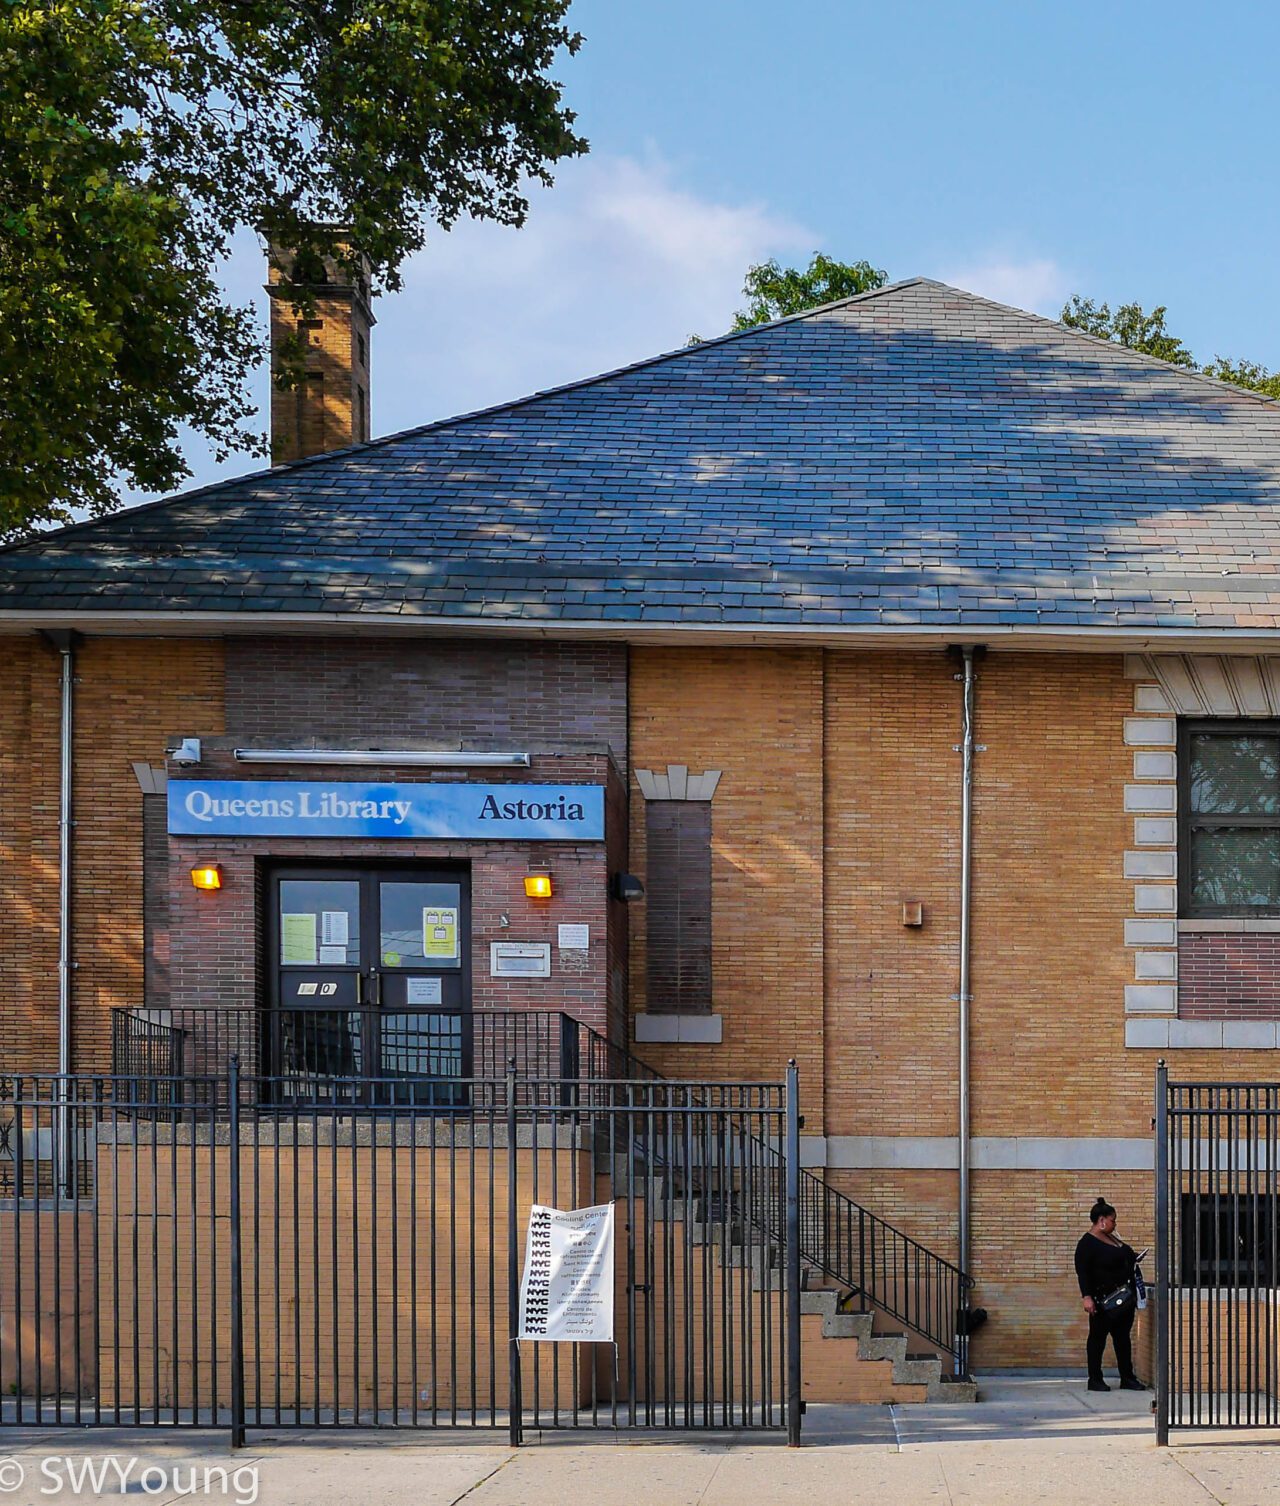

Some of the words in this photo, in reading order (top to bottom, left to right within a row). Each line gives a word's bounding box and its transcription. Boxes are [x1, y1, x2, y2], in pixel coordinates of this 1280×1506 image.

[185, 790, 294, 821] Queens
[298, 791, 412, 825] Library
[477, 794, 585, 821] Astoria
[531, 1221, 551, 1229] NYC
[530, 1269, 550, 1277] NYC
[527, 1288, 549, 1296] NYC
[526, 1297, 549, 1305] NYC
[526, 1307, 549, 1315] NYC
[525, 1316, 548, 1324] NYC
[525, 1325, 547, 1334] NYC
